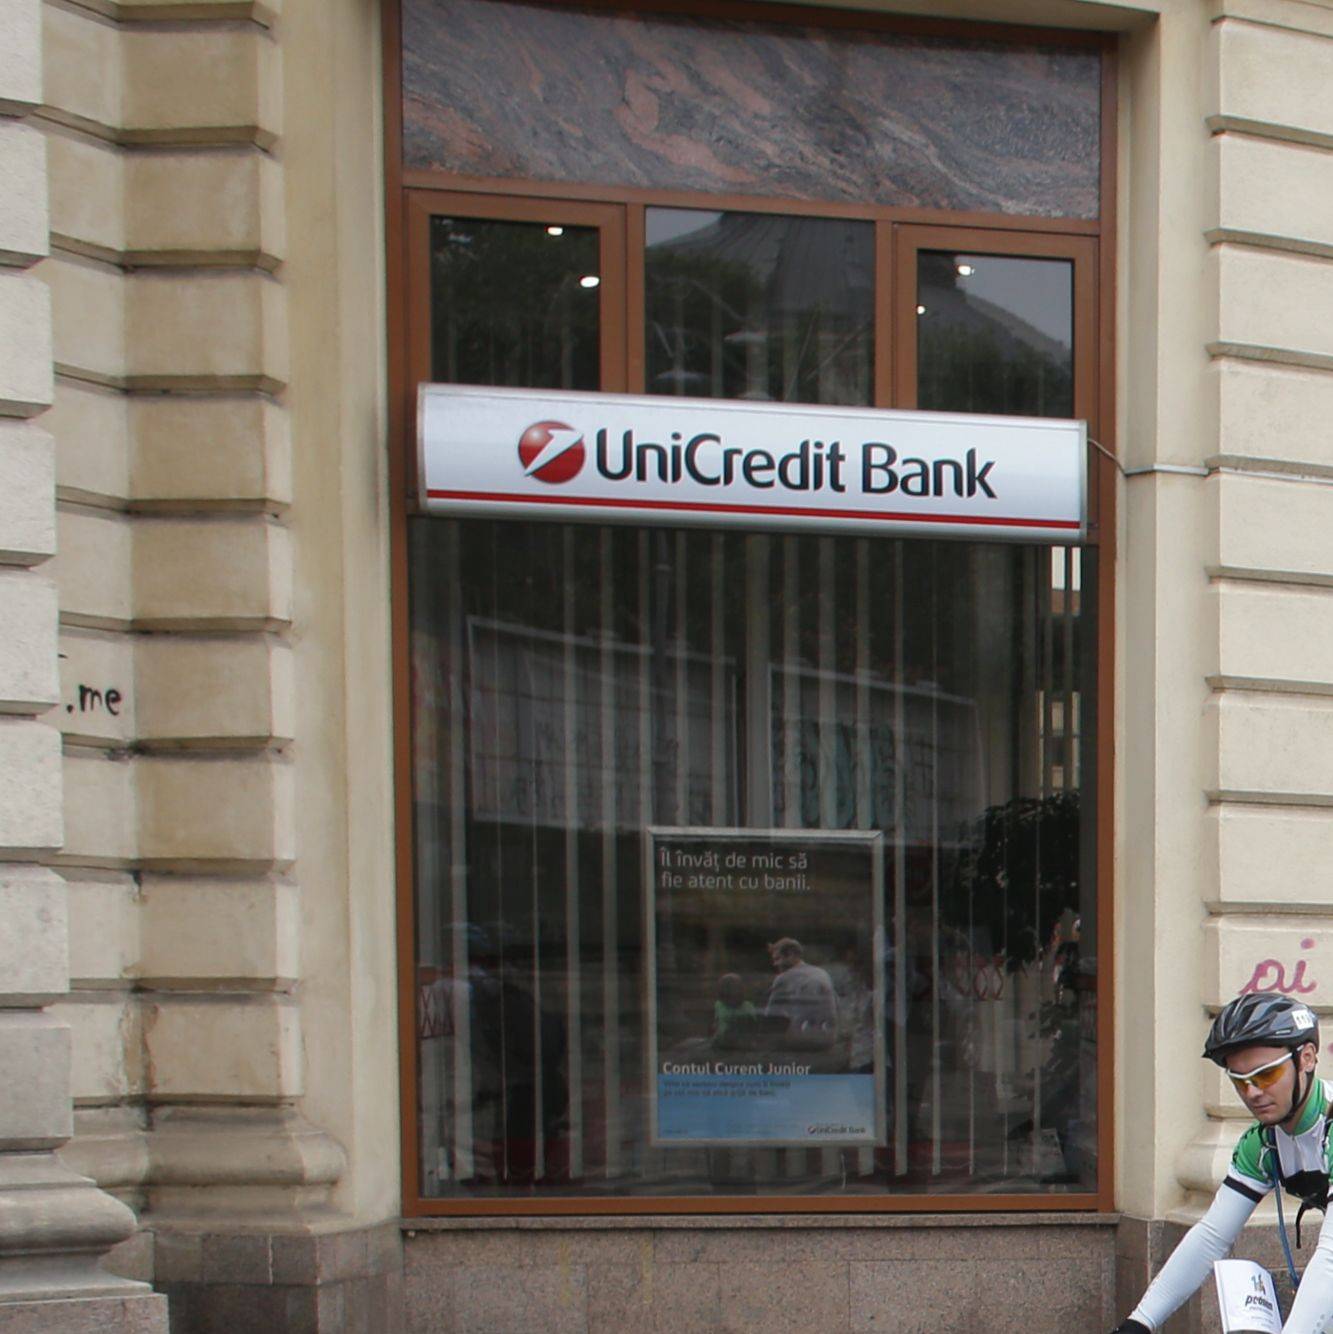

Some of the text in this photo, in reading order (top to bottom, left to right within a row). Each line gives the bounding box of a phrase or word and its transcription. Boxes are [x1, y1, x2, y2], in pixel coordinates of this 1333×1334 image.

[595, 428, 998, 499] UniCredit Bank
[725, 851, 747, 868] de
[752, 851, 783, 868] mic
[789, 852, 808, 869] să
[661, 872, 811, 891] fie atent cu banii.
[663, 1061, 811, 1076] Contul Curent Junior
